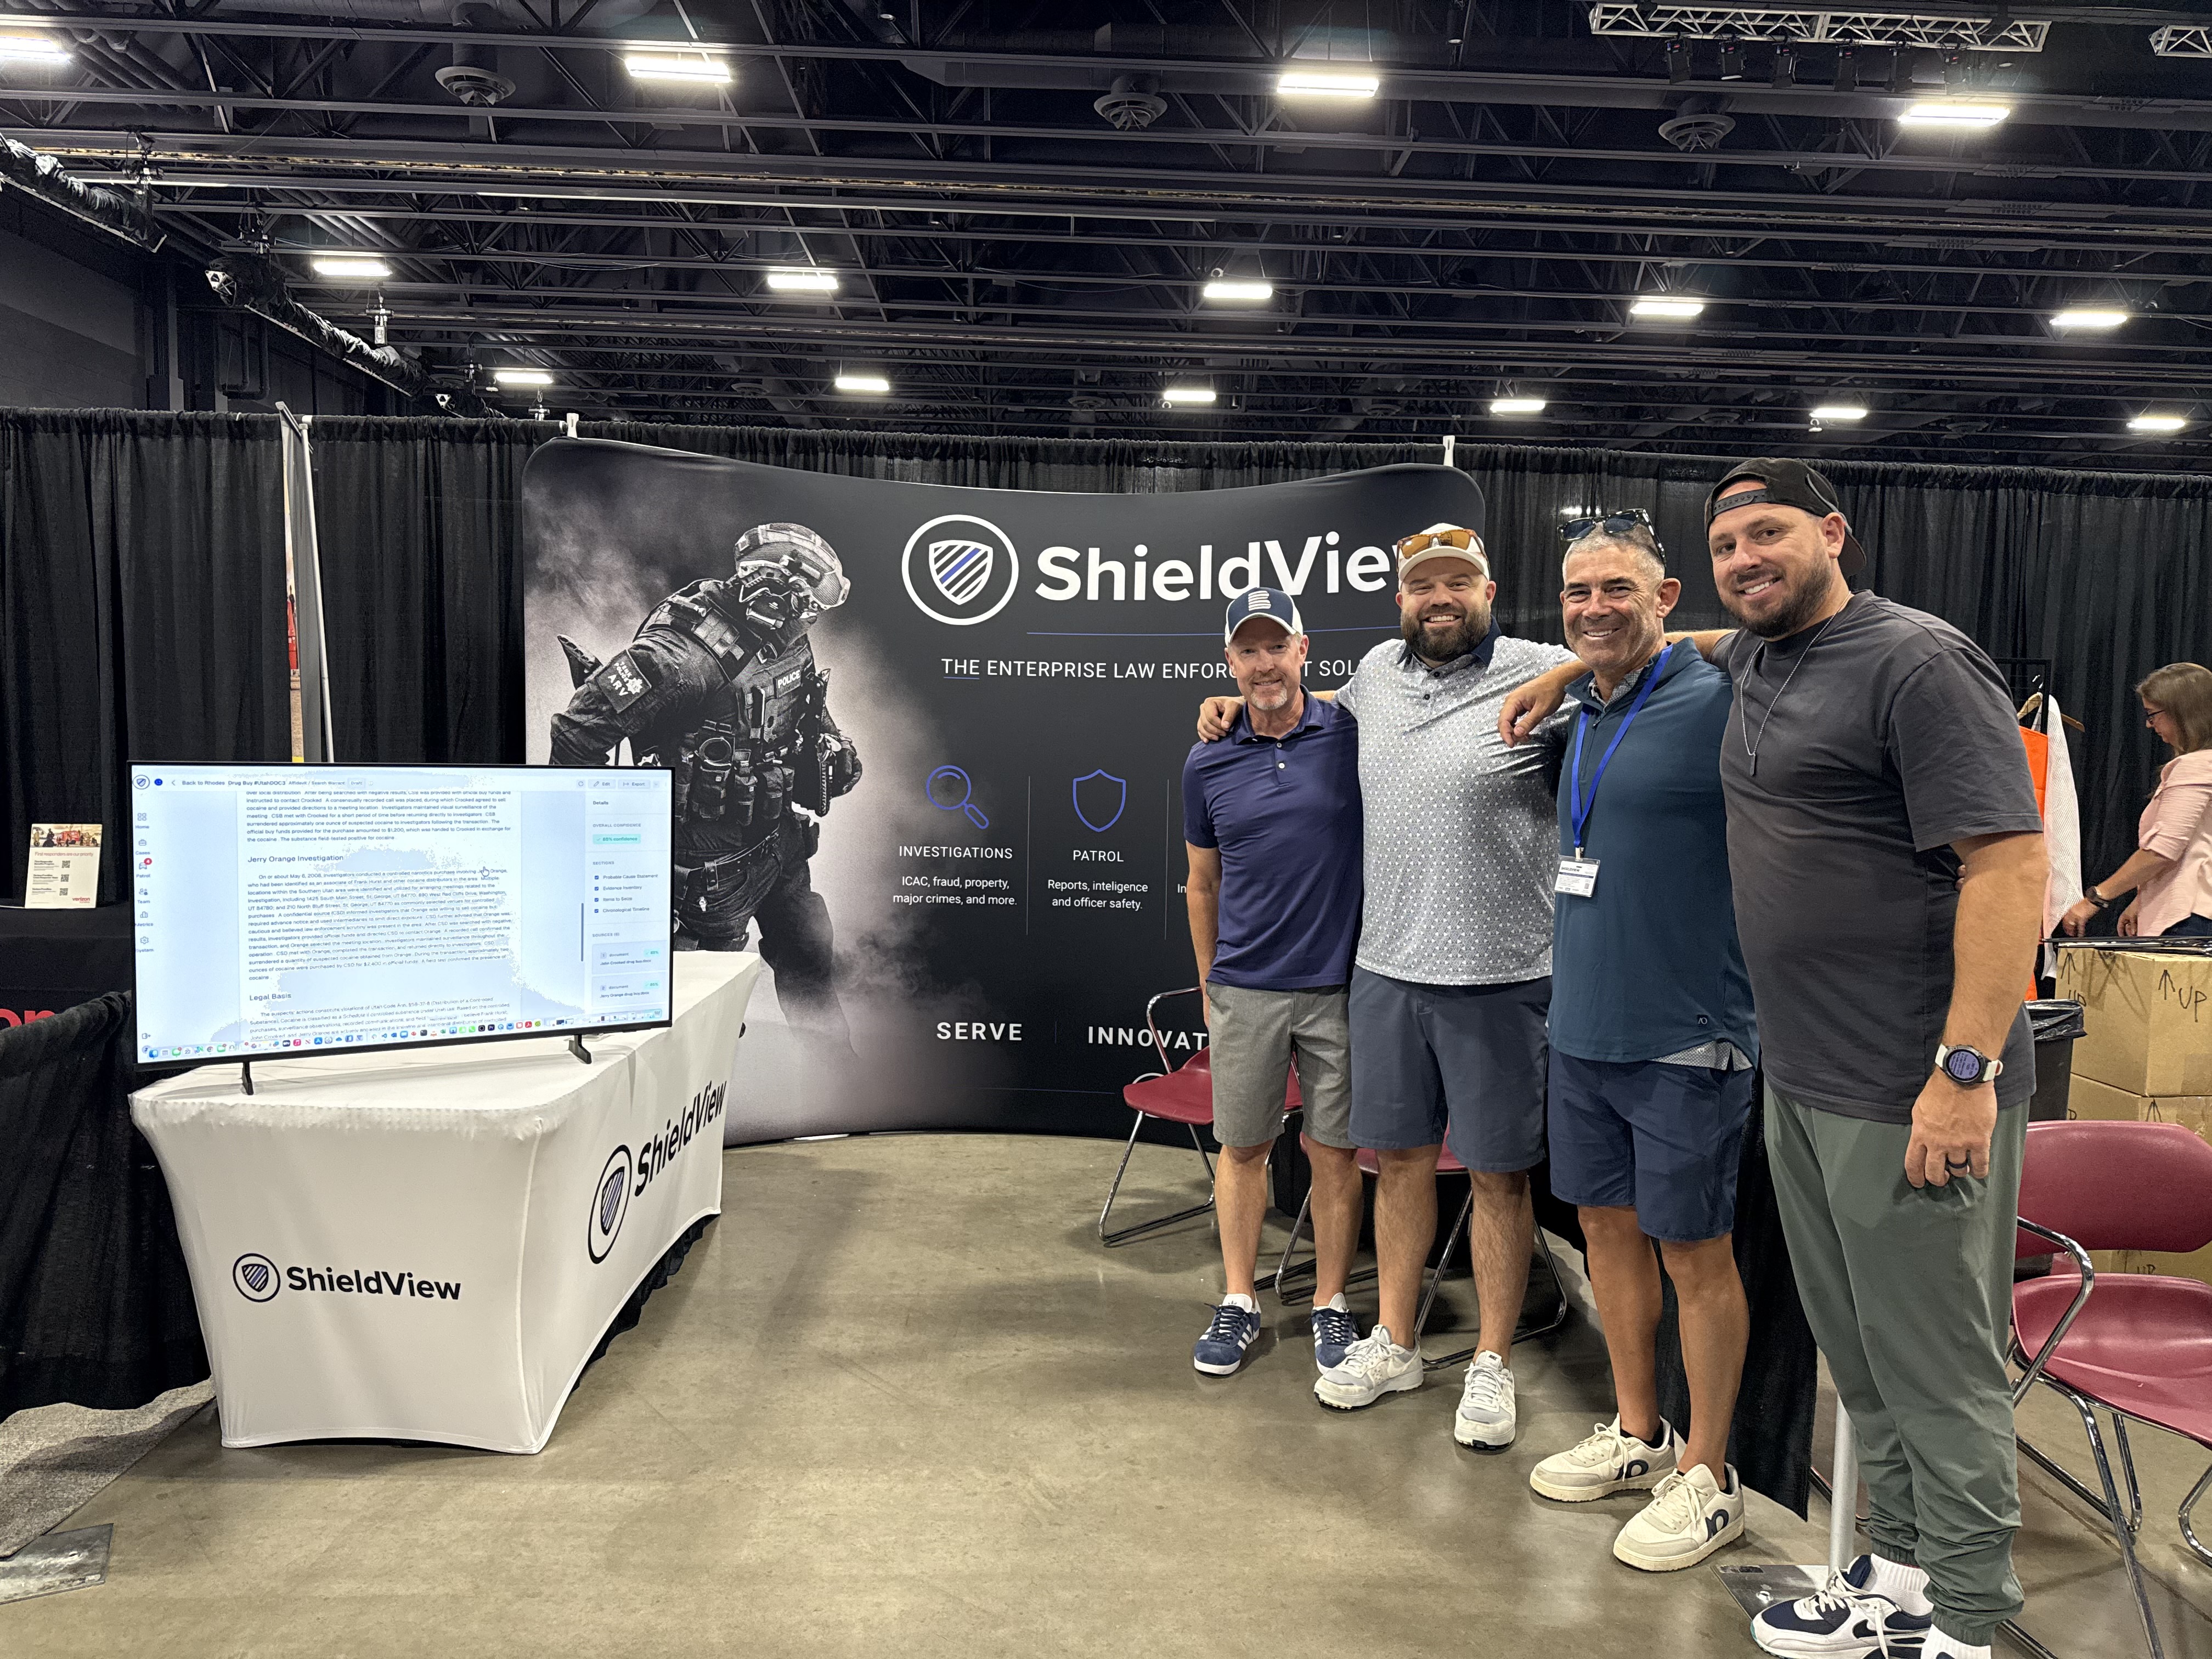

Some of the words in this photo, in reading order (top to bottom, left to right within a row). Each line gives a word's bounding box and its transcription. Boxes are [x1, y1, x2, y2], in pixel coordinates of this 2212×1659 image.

[1035, 532, 1398, 601] ShieldVie
[941, 658, 979, 674] THE
[988, 661, 1106, 678] ENTERPRISE
[1114, 663, 1155, 678] LAW
[608, 675, 629, 696] ARV
[777, 669, 800, 689] POLICE
[900, 846, 1012, 859] INVESTIGATIONS
[1074, 850, 1124, 862] PATROL
[902, 876, 930, 887] ICAC,
[933, 876, 962, 888] fraud,
[965, 879, 1009, 890] property,
[1048, 879, 1090, 891] Reports,
[1093, 881, 1148, 893] inteligence
[893, 894, 923, 905] major
[926, 894, 963, 905] crimes,
[966, 895, 985, 904] and
[1052, 897, 1070, 906] and
[1074, 897, 1107, 907] officer
[1110, 899, 1142, 911] safety.
[2179, 986, 2207, 1023] UP
[937, 1022, 1022, 1041] SERVE
[1088, 1026, 1207, 1050] INNOVAT
[634, 1080, 727, 1197] ShieldView
[286, 1266, 461, 1300] ShieldView
